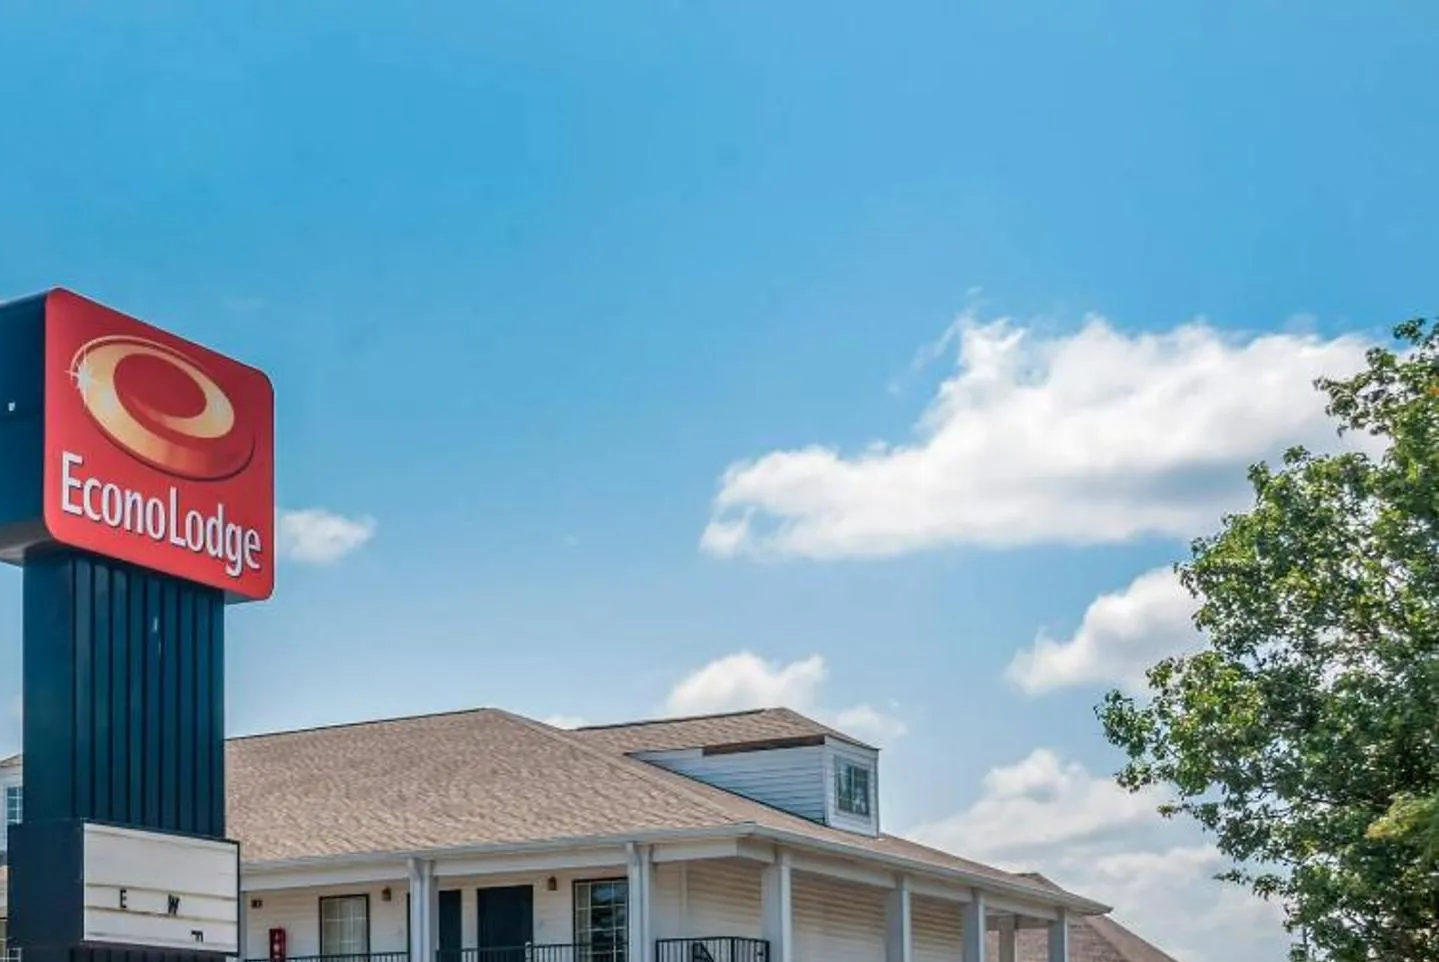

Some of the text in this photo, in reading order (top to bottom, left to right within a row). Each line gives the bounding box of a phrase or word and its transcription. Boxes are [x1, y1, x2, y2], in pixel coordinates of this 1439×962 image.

[62, 451, 261, 577] EconoLodge
[120, 889, 180, 915] E W
